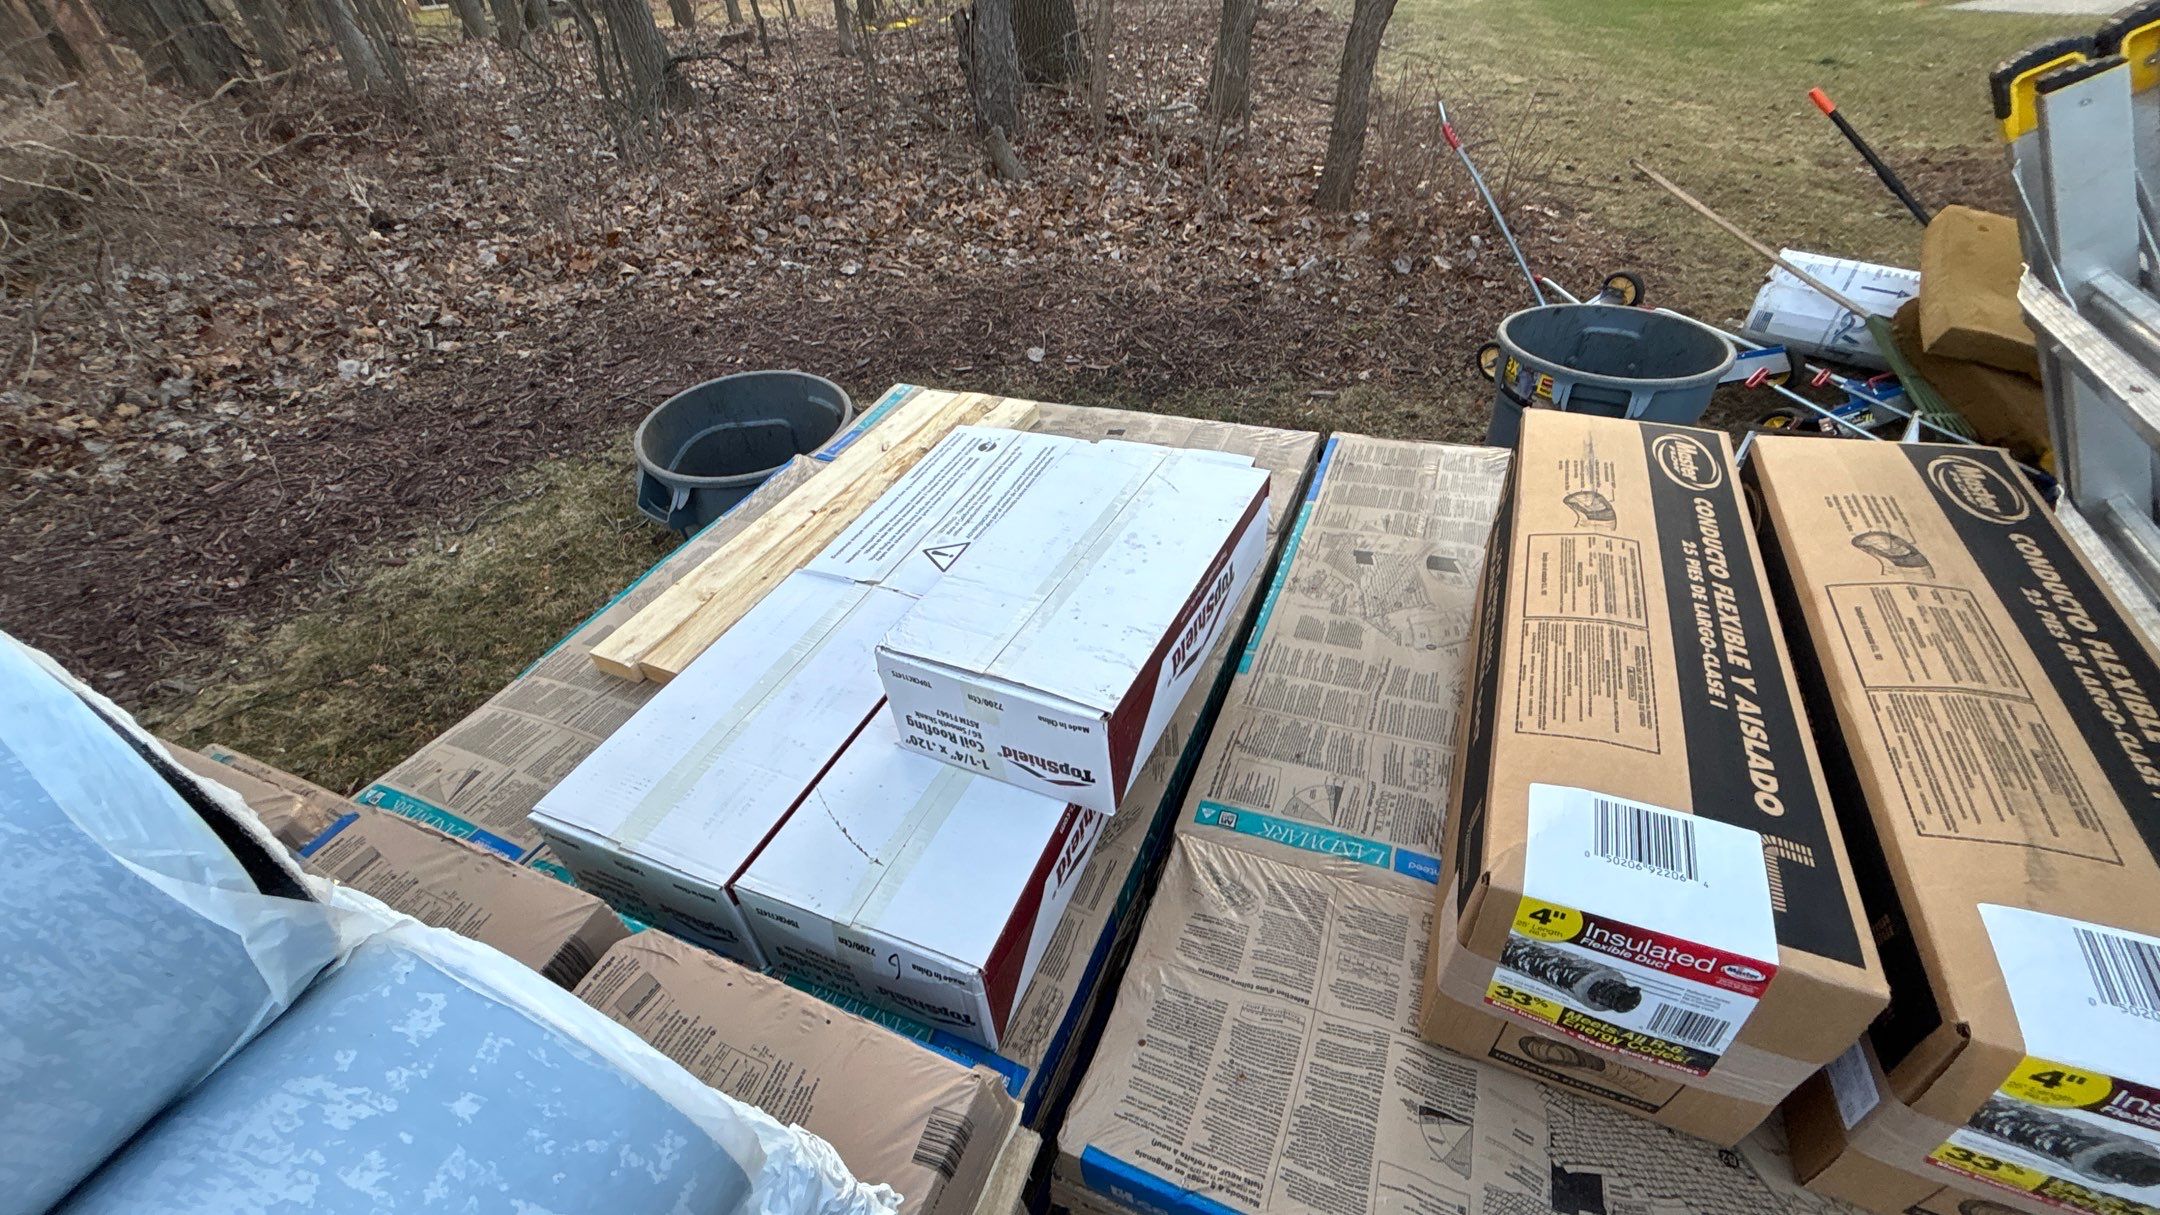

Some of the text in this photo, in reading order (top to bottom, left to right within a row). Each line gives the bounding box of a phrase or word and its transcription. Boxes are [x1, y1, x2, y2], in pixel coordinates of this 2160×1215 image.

[1674, 440, 1699, 482] Master
[1952, 464, 2001, 513] Master
[1681, 539, 1698, 554] 25
[1684, 556, 1704, 584] PIES
[1691, 583, 1708, 603] DE
[1172, 561, 1235, 678] TopShield
[2008, 533, 2160, 744] CONDUCTO FLEXIBLE
[2036, 608, 2071, 640] PIES
[2058, 642, 2088, 665] DE
[1693, 603, 1726, 702] LARGO-CLASE
[1693, 497, 1785, 817] CONDUCTO FLEXIBLE Y AISLADO
[967, 693, 1004, 711] 7200/Ctn
[914, 710, 941, 726] Shank
[941, 718, 967, 735] Smooth
[959, 717, 980, 729] ASTM
[1037, 714, 1058, 727] China
[1067, 723, 1090, 734] Made
[905, 715, 985, 753] Coil Roofing
[1000, 745, 1096, 784] TopShield
[1056, 807, 1096, 888] hield
[1257, 821, 1387, 865] LANDMARK
[1584, 850, 1590, 858] 0
[1605, 855, 1643, 872] 50206
[1648, 865, 1687, 882] 92206
[1529, 907, 1567, 926] 4"
[1532, 924, 1564, 938] Length
[838, 936, 877, 957] 7200/Ctn
[1579, 937, 1670, 971] Flexible Duct
[1584, 922, 1717, 975] Insulated
[911, 963, 933, 979] China
[1727, 965, 1760, 981] Master
[877, 985, 976, 1027] TopShield
[1494, 985, 1549, 1009] 33%
[2088, 997, 2160, 1023] 0 5020
[1492, 1000, 1515, 1012] More
[1518, 1009, 1566, 1034] Insulation
[1576, 1033, 1617, 1052] Greater
[1618, 1048, 1655, 1063] Energy
[1657, 1059, 1700, 1076] Savings
[1562, 1019, 1624, 1046] Energy
[1626, 1040, 1694, 1063] Codes!
[1565, 1010, 1618, 1036] Meets
[1621, 1031, 1648, 1046] All
[2028, 1070, 2087, 1089] 4"
[2110, 1089, 2160, 1115] Ins
